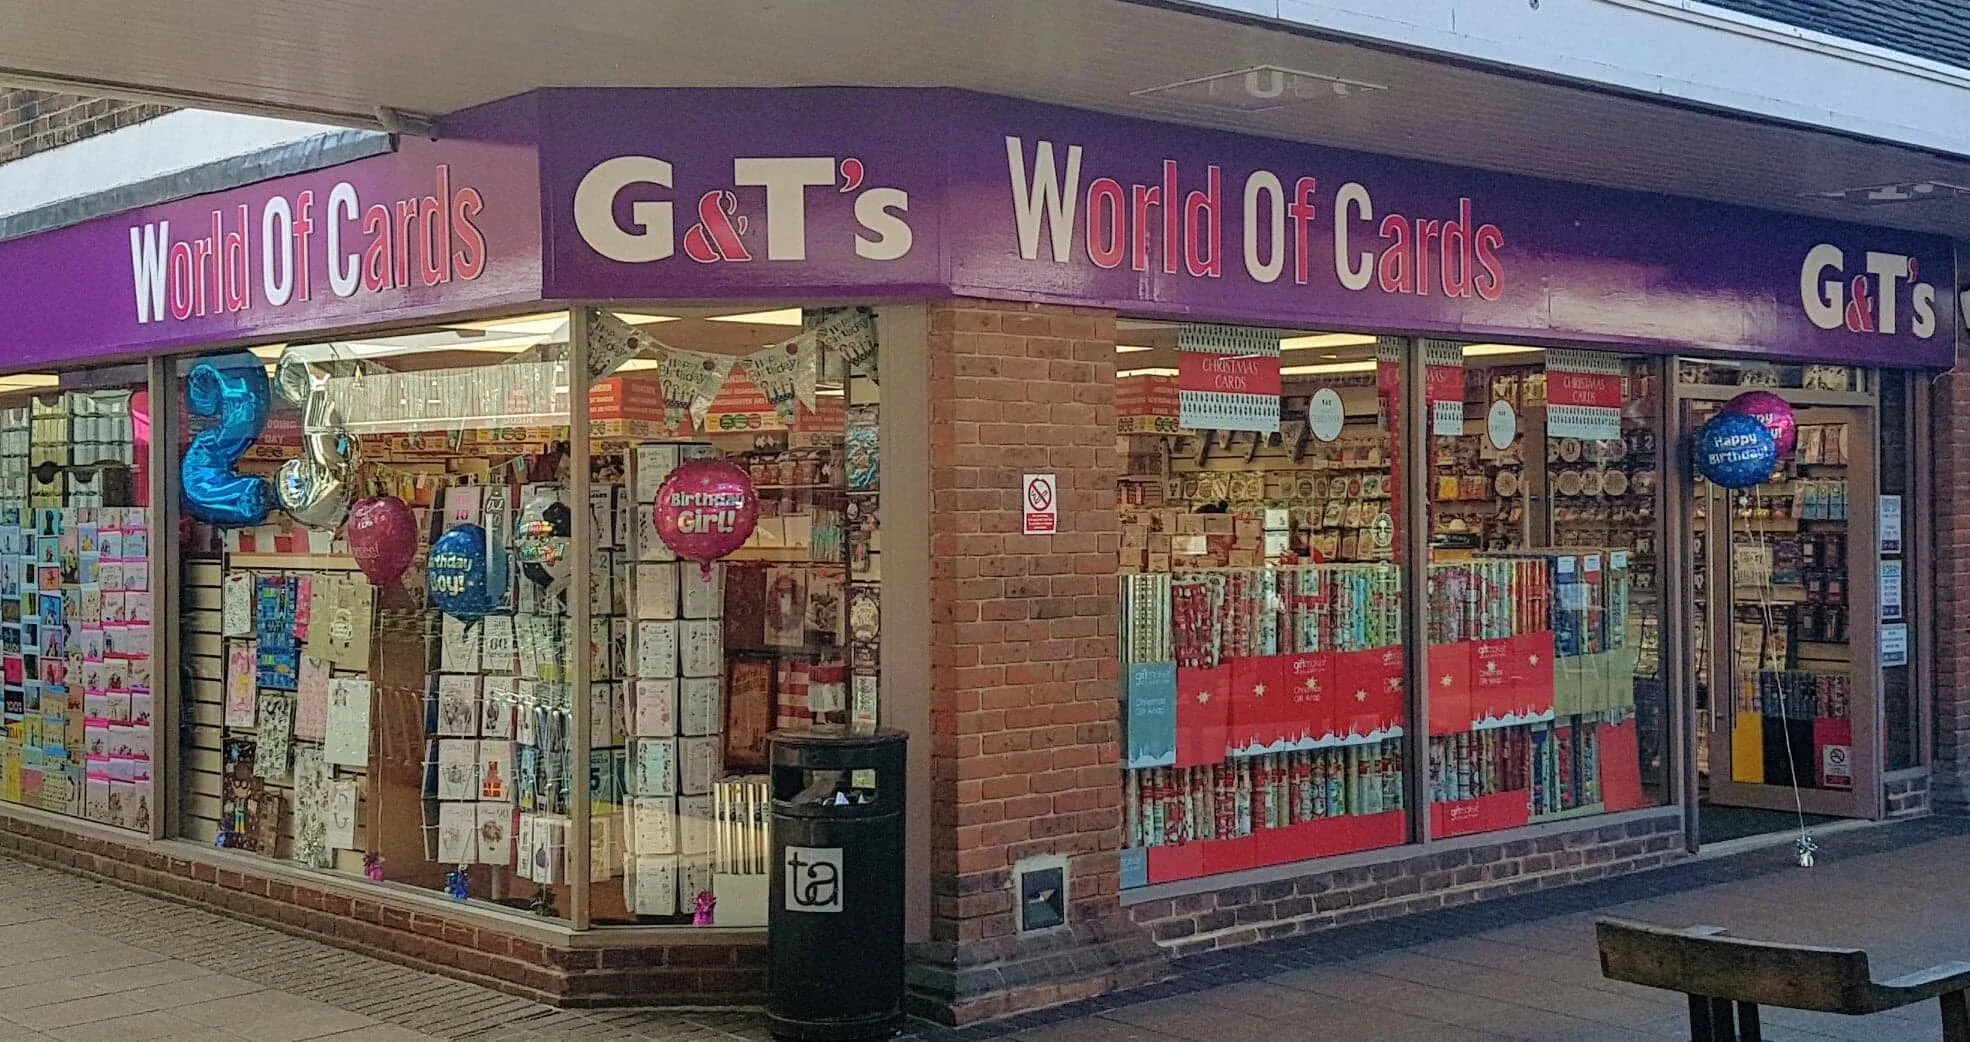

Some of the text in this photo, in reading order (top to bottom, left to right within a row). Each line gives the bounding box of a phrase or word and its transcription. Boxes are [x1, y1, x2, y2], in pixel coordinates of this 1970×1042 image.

[573, 156, 914, 264] G&T's
[1005, 136, 1506, 301] World Of Cards
[130, 164, 487, 323] World Of Cards
[1800, 243, 1936, 339] G&T's
[1202, 358, 1260, 375] CHRISTMAS
[1214, 374, 1247, 390] CARDS
[1713, 432, 1758, 448] Happy
[1707, 445, 1769, 466] Birthday!
[671, 491, 745, 510] Birthday
[677, 509, 736, 534] Girl!
[788, 851, 840, 907] ta
